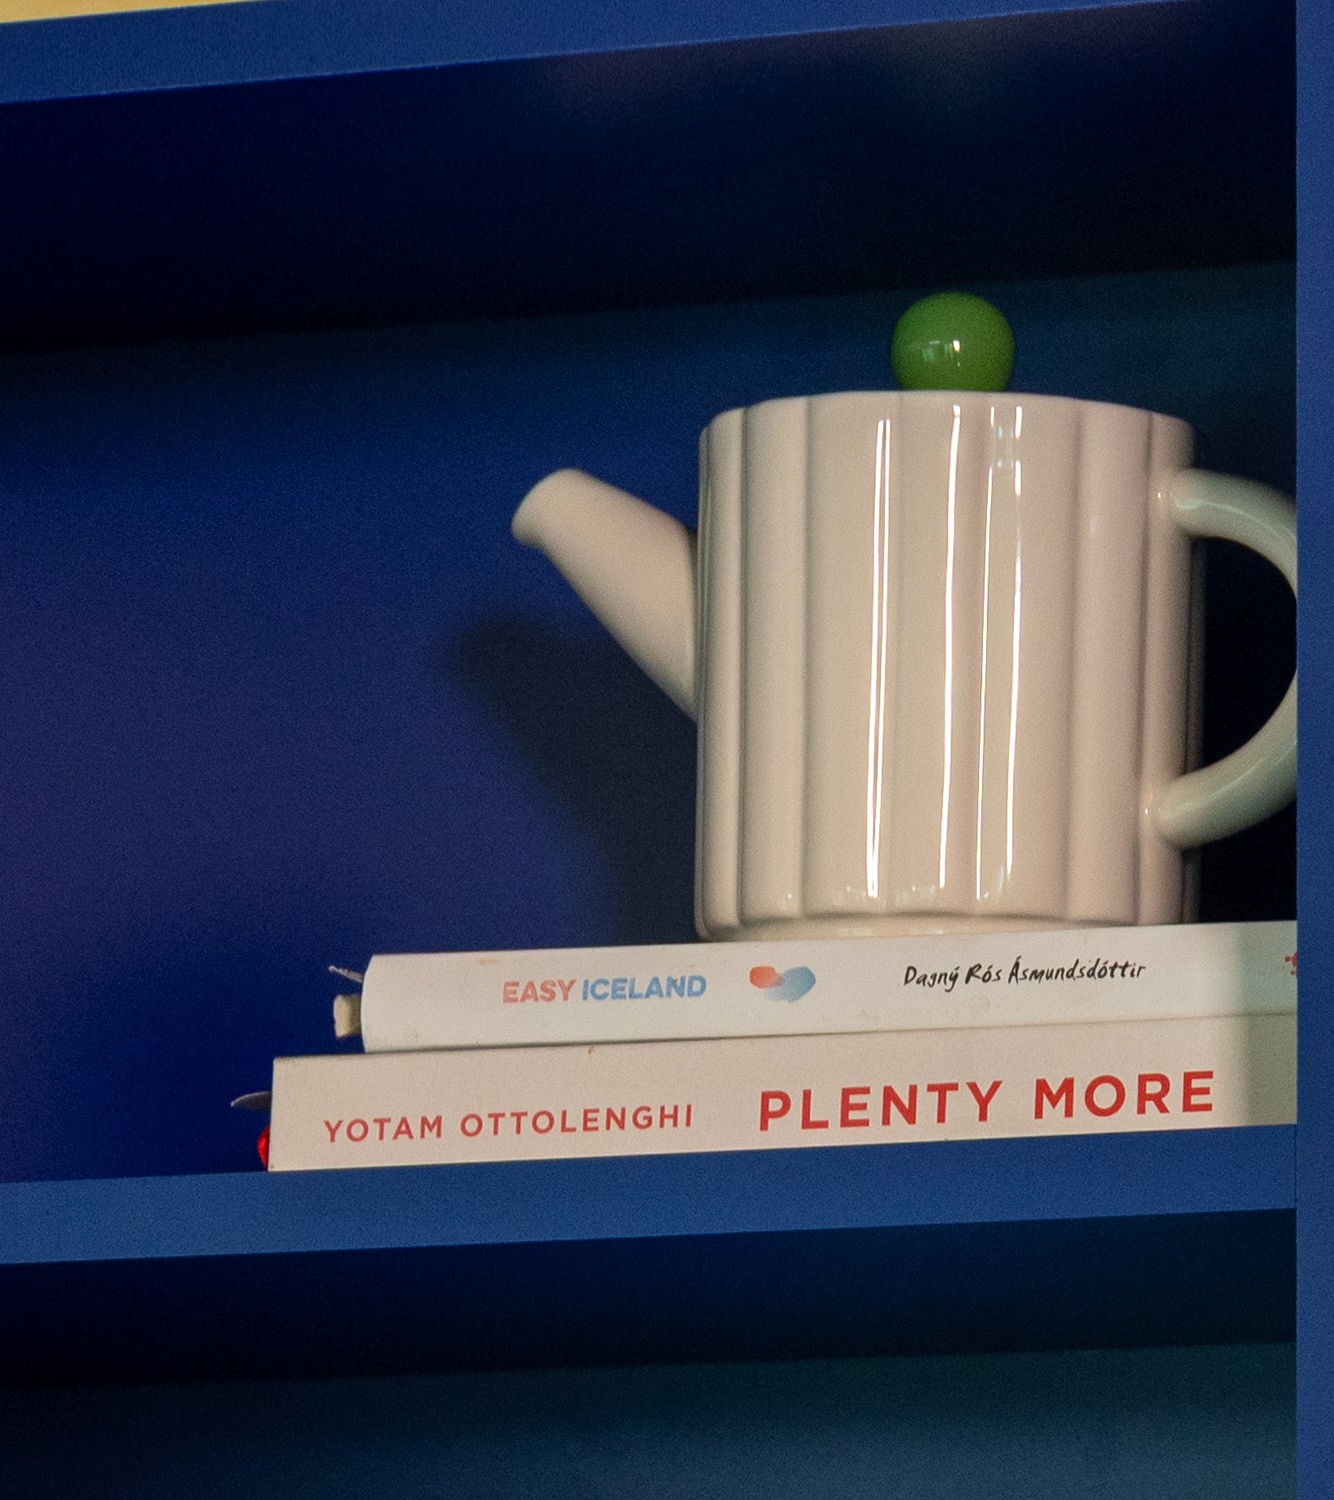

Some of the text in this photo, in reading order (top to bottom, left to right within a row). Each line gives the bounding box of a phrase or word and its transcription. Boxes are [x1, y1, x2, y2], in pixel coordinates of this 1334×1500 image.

[502, 974, 708, 1004] EASY ICELAND
[904, 956, 1147, 993] Dagný Rós Ásmundsdóttir
[759, 1070, 1215, 1132] PLENTY MORE
[323, 1103, 693, 1143] YOTAM OTTOLENGHI
